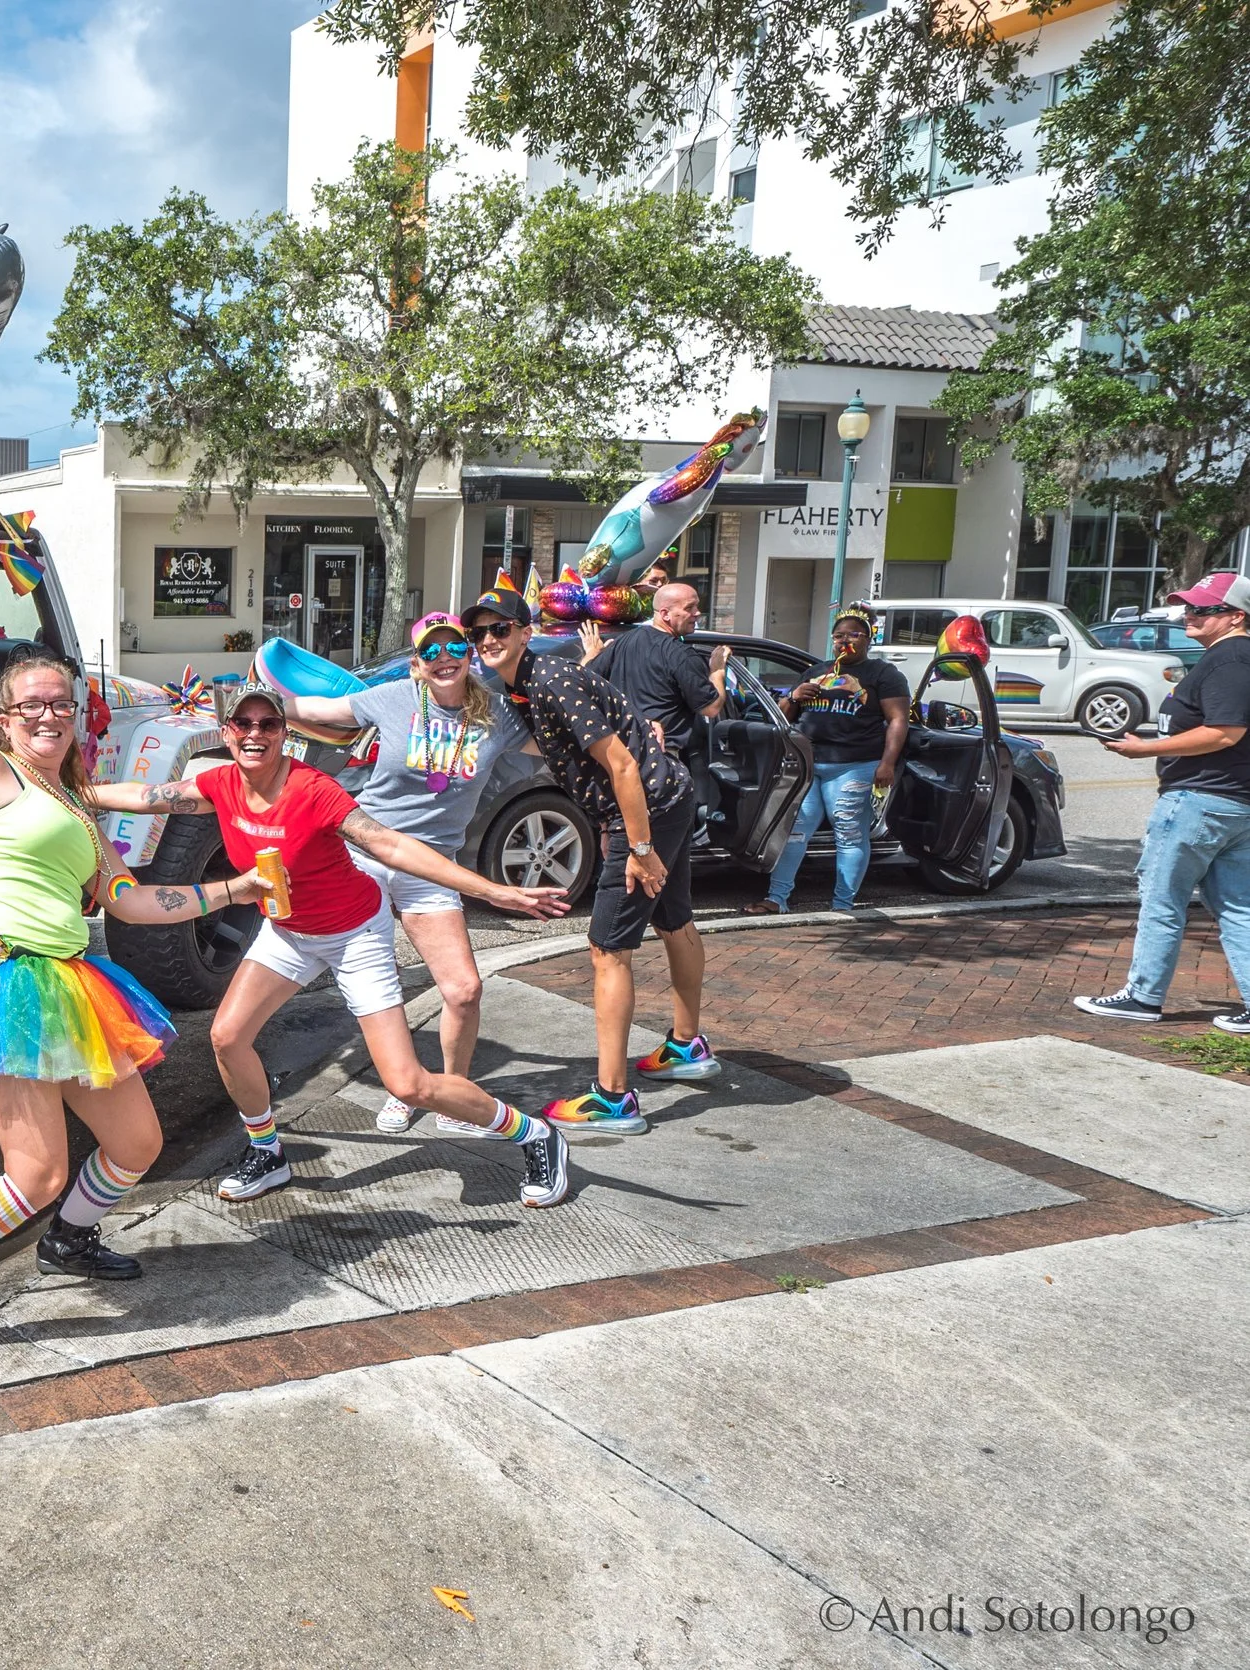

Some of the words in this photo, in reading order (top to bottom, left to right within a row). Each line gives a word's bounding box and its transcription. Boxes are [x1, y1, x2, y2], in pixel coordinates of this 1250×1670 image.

[266, 525, 301, 533] KITCHEN
[314, 525, 353, 534] FLOORING
[325, 560, 346, 568] SUITE
[167, 588, 196, 596] Affordable
[196, 588, 215, 596] Luxury
[831, 698, 862, 716] ALLY
[406, 736, 479, 781] WINS
[116, 736, 161, 840] PRE
[258, 827, 284, 836] Friend
